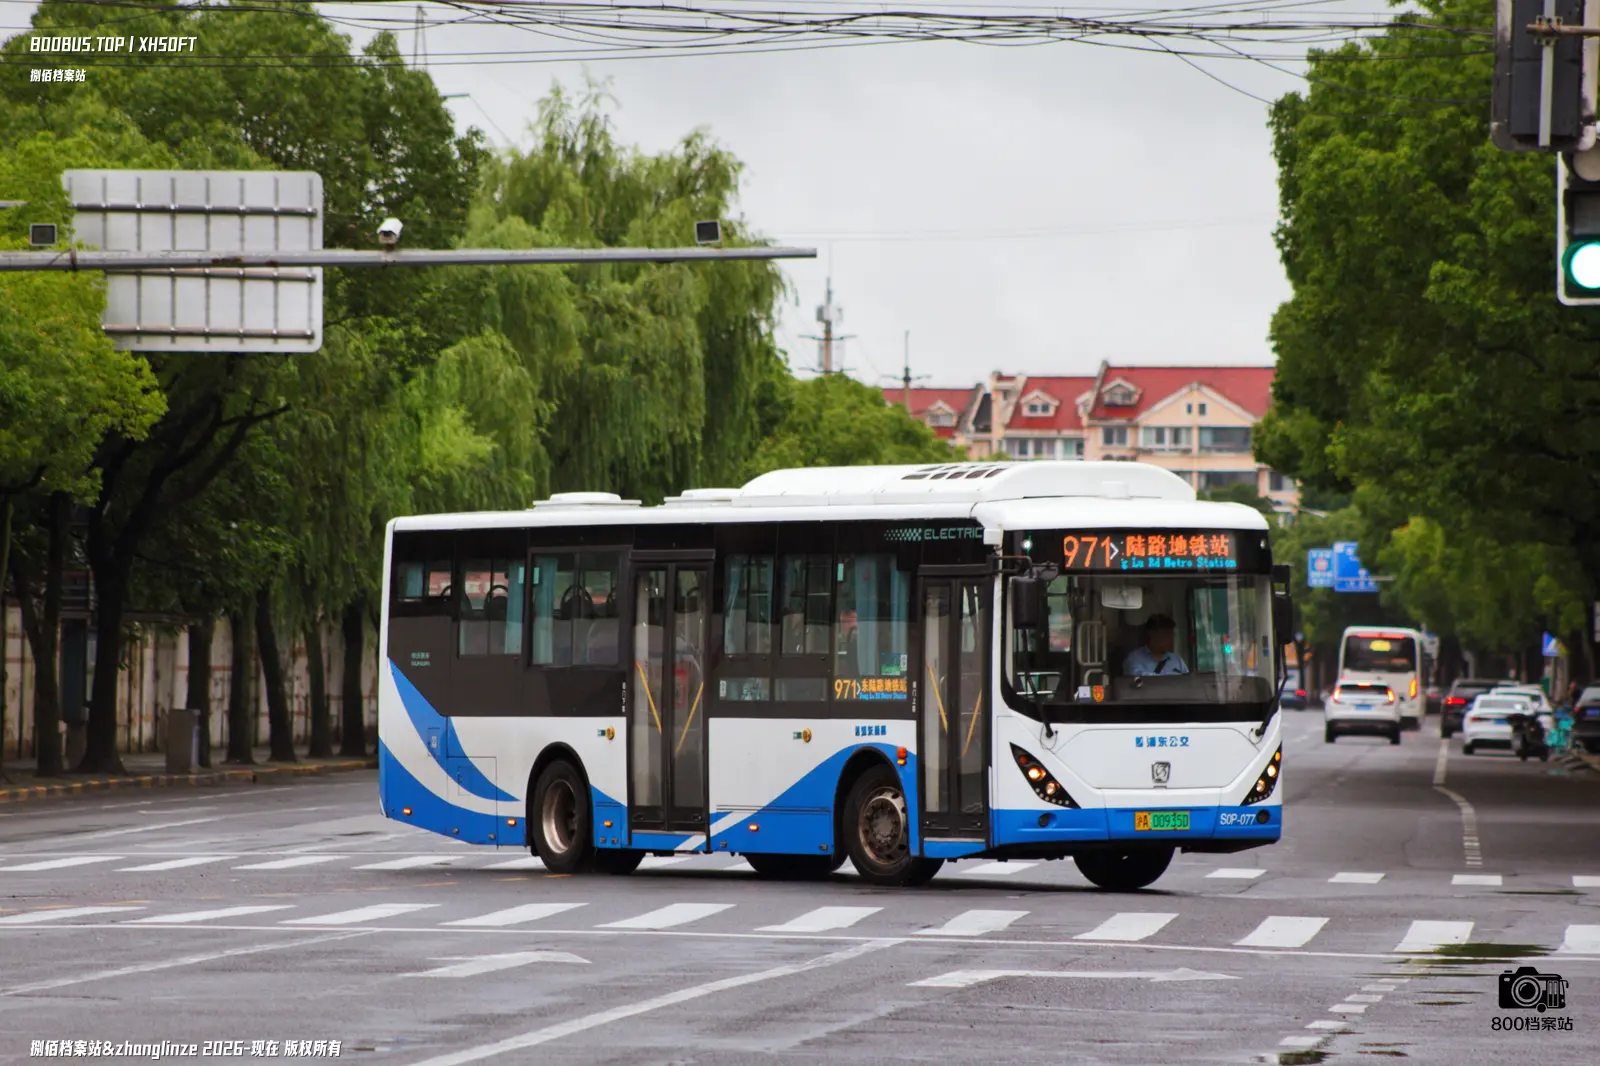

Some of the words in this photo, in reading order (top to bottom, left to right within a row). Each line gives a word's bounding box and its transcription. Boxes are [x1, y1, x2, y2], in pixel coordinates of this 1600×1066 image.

[924, 527, 984, 539] ELECTRIC
[1063, 536, 1111, 568] 971
[1121, 535, 1229, 556] 陆路地铁站
[1196, 556, 1237, 568] Station
[834, 679, 857, 699] 971
